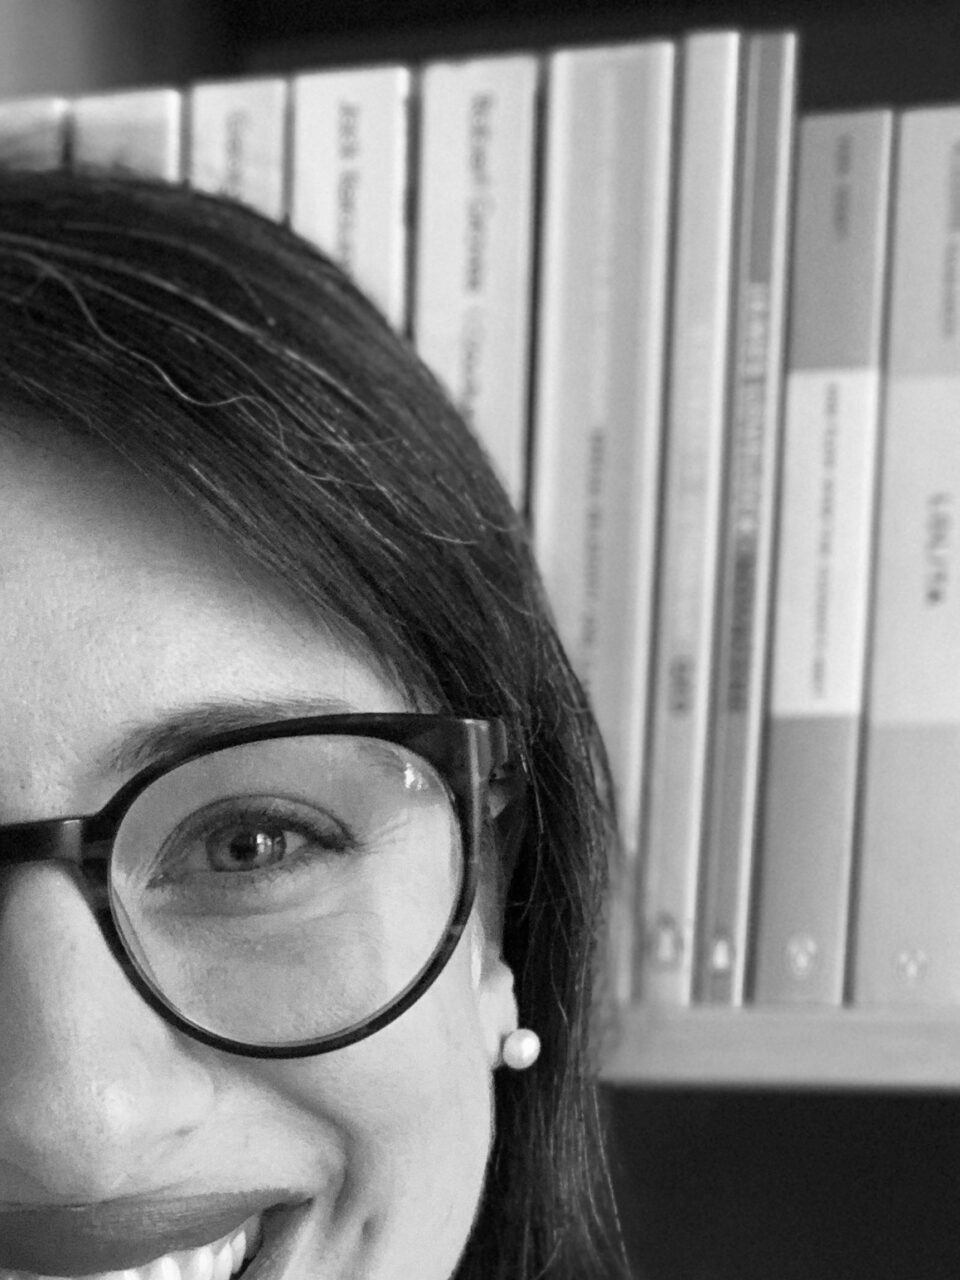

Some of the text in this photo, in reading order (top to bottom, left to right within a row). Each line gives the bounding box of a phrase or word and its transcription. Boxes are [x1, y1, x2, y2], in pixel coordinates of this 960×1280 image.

[467, 93, 497, 187] Robert
[464, 196, 494, 294] Graves
[923, 492, 952, 608] LOLITA
